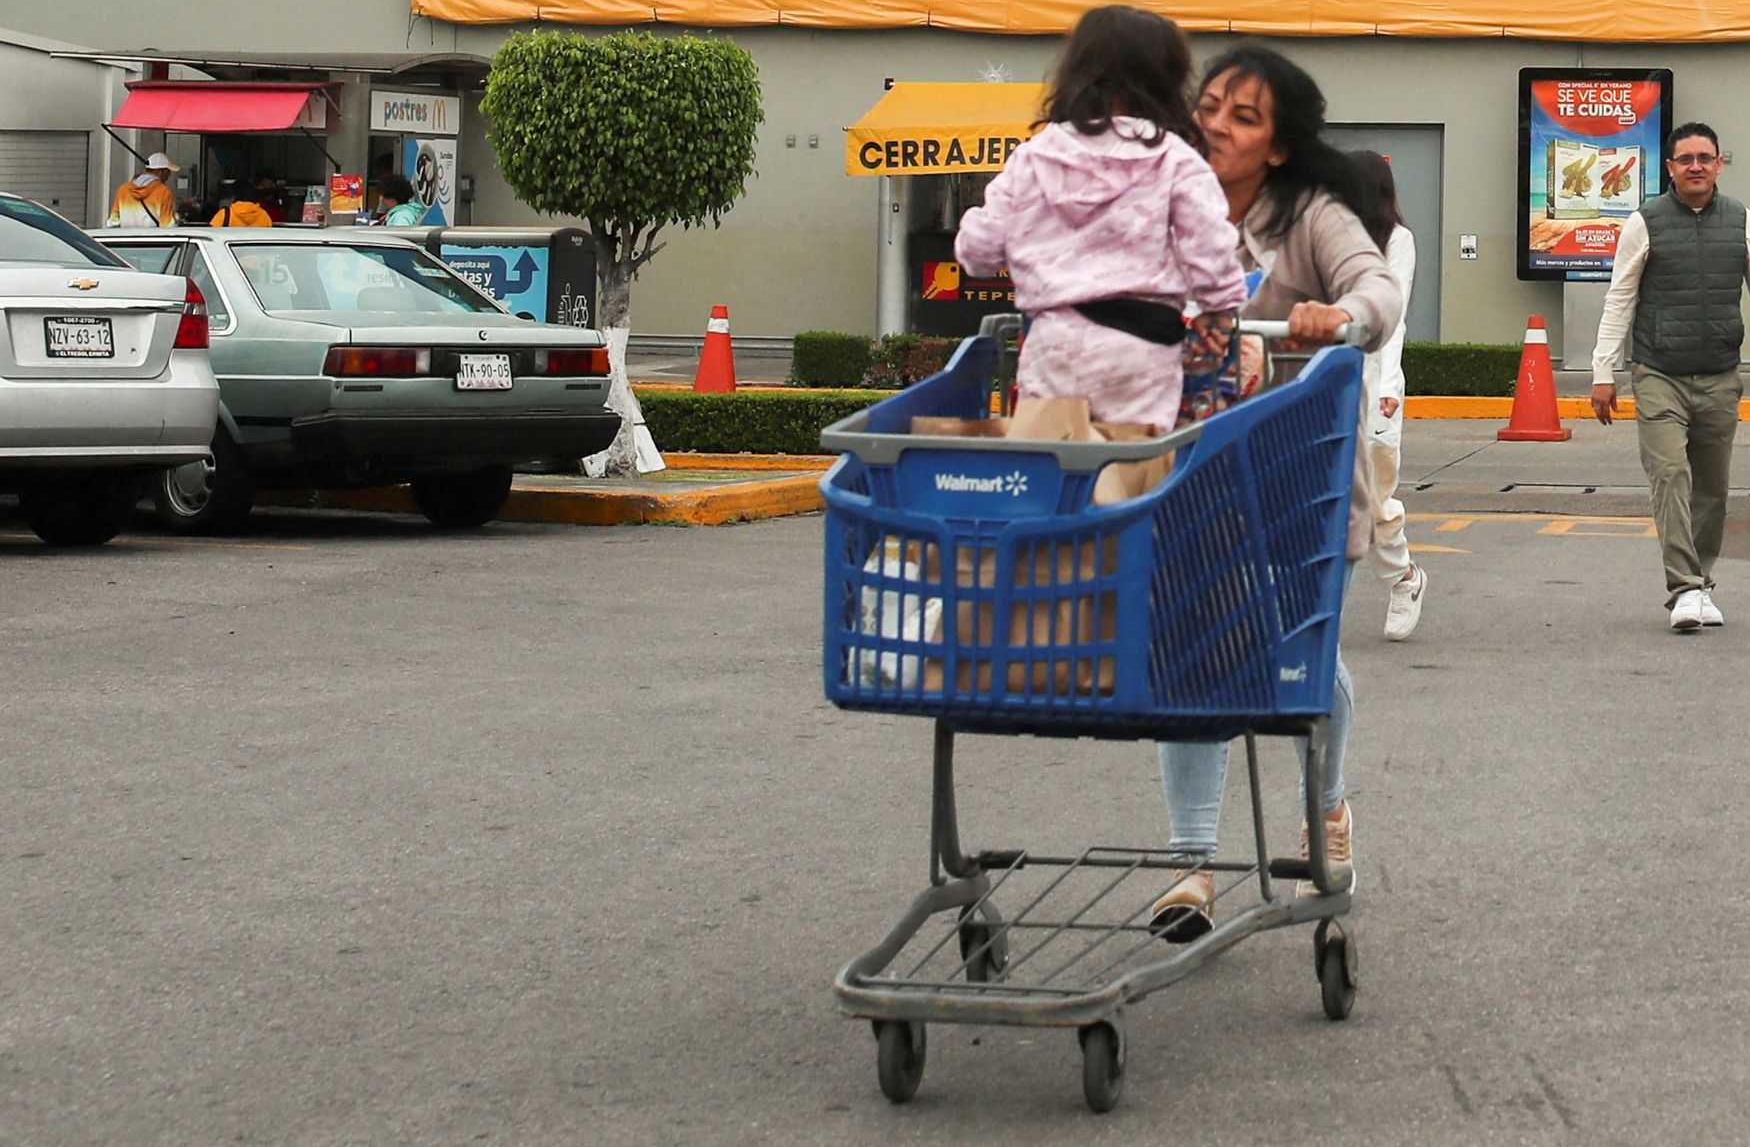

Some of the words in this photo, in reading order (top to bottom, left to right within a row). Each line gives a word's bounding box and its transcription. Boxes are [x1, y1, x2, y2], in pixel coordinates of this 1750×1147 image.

[1557, 89, 1574, 103] SE
[1577, 89, 1597, 103] VE
[1600, 89, 1631, 103] QUE
[384, 98, 428, 127] postres
[1558, 104, 1574, 116] TE
[1578, 104, 1632, 117] CUIDAS
[859, 138, 1031, 169] CERRAJER
[449, 260, 476, 270] deposita
[483, 272, 493, 287] y
[49, 327, 110, 345] NZV-63-12
[460, 363, 510, 378] NTK-90-05
[935, 473, 1005, 493] Walmart
